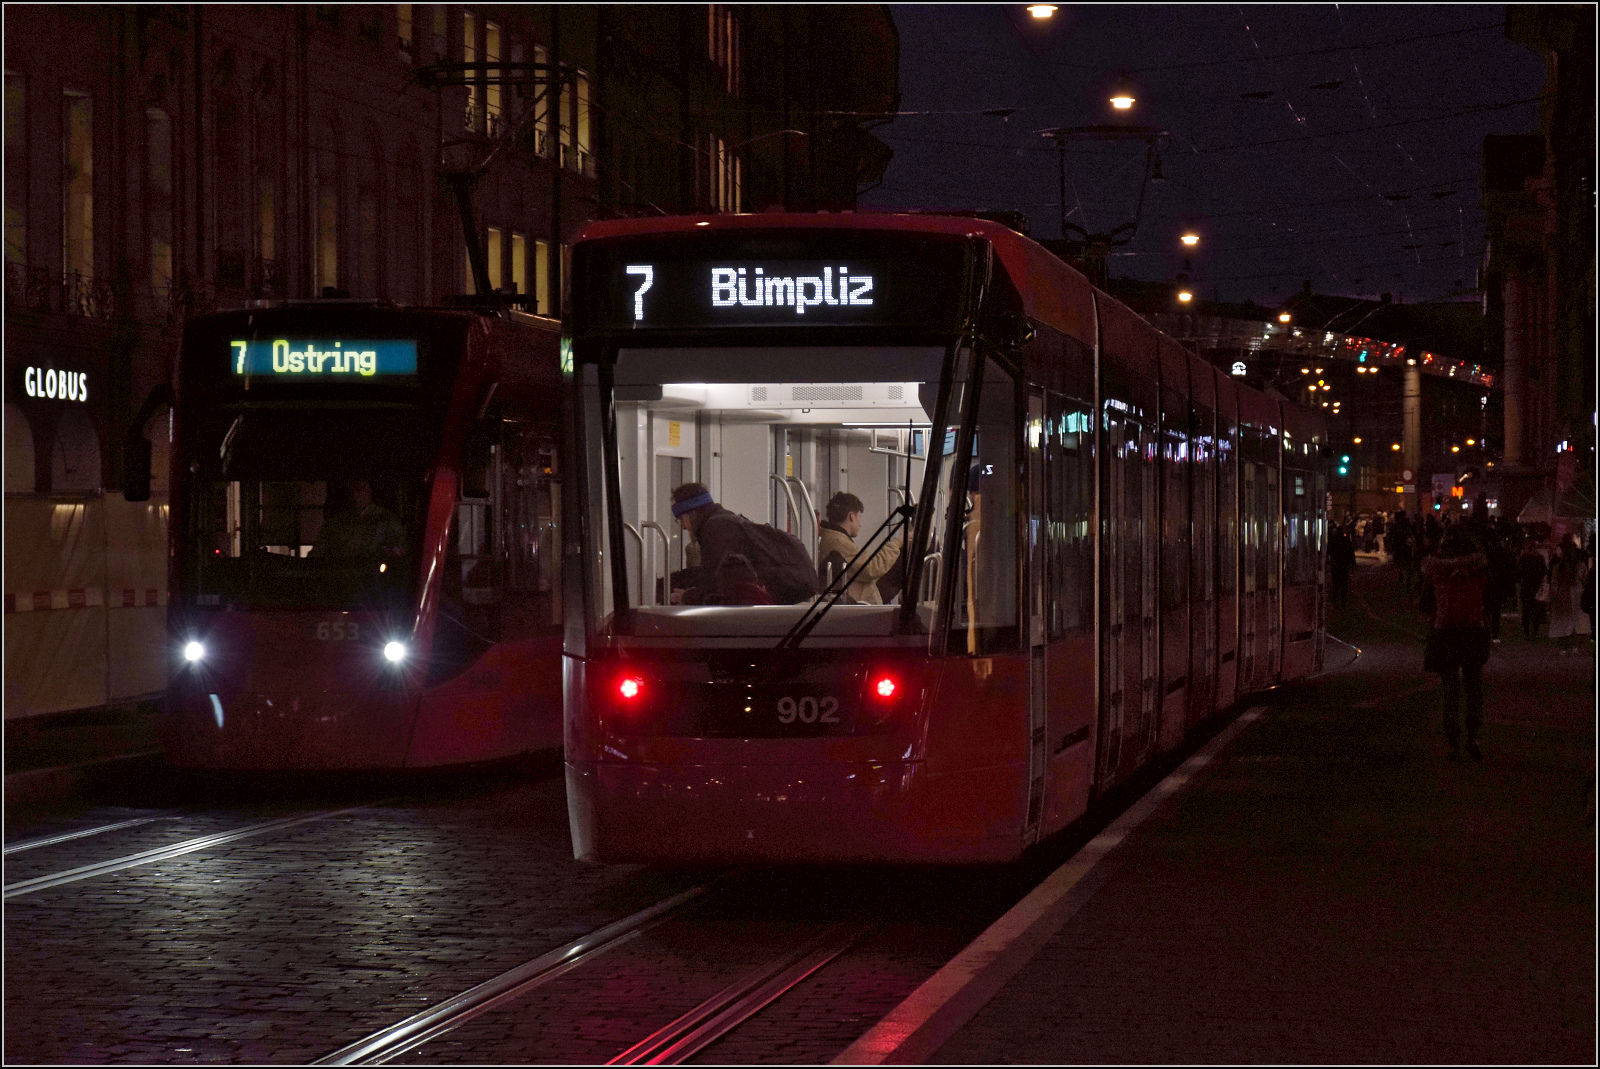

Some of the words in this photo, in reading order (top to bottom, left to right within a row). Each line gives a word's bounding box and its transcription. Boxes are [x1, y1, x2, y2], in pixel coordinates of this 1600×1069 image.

[626, 265, 654, 321] 7
[711, 266, 874, 315] Bümpliz
[230, 340, 248, 374] 7
[271, 339, 377, 376] Ostring
[24, 366, 89, 403] GLOBUS
[316, 621, 360, 641] 653
[777, 696, 840, 724] 902
